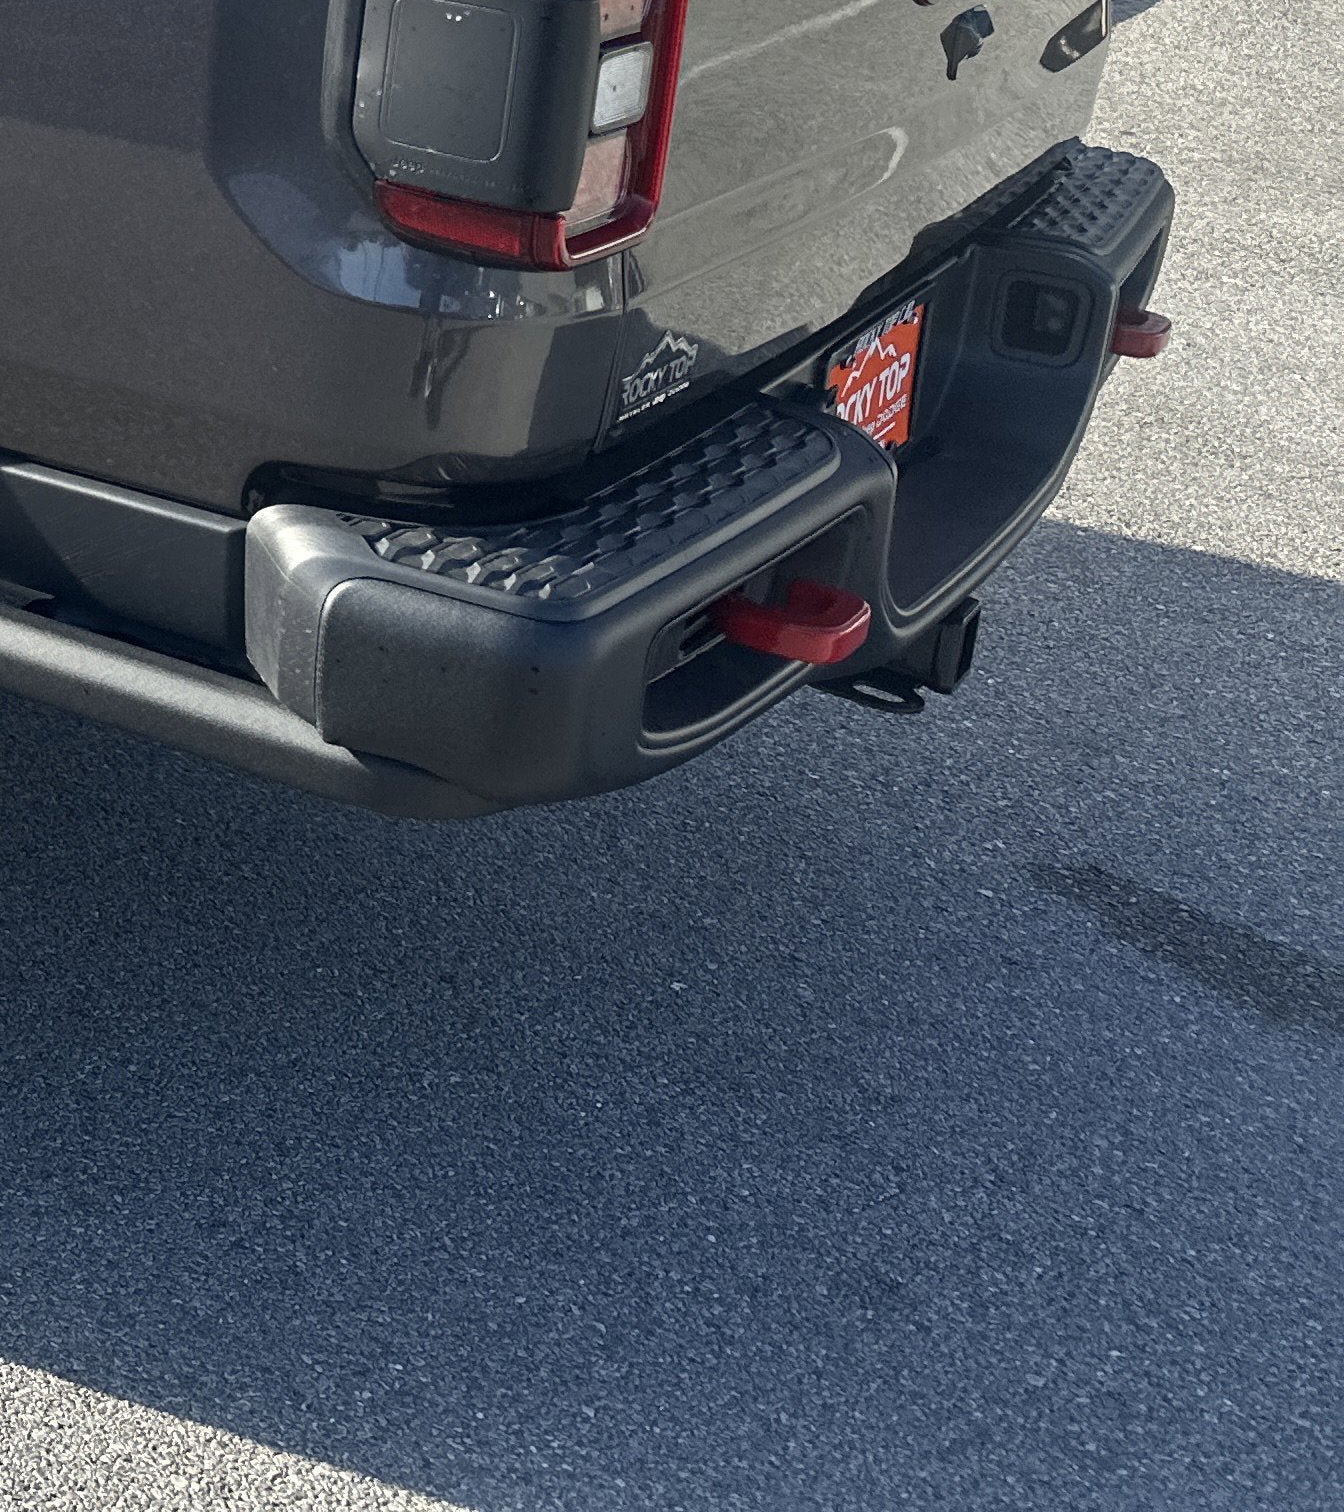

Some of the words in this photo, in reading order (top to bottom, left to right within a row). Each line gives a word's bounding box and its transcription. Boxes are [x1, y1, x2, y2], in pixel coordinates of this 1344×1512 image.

[620, 363, 670, 406] ROCKY
[836, 377, 878, 426] CKY
[878, 353, 911, 408] TOP
